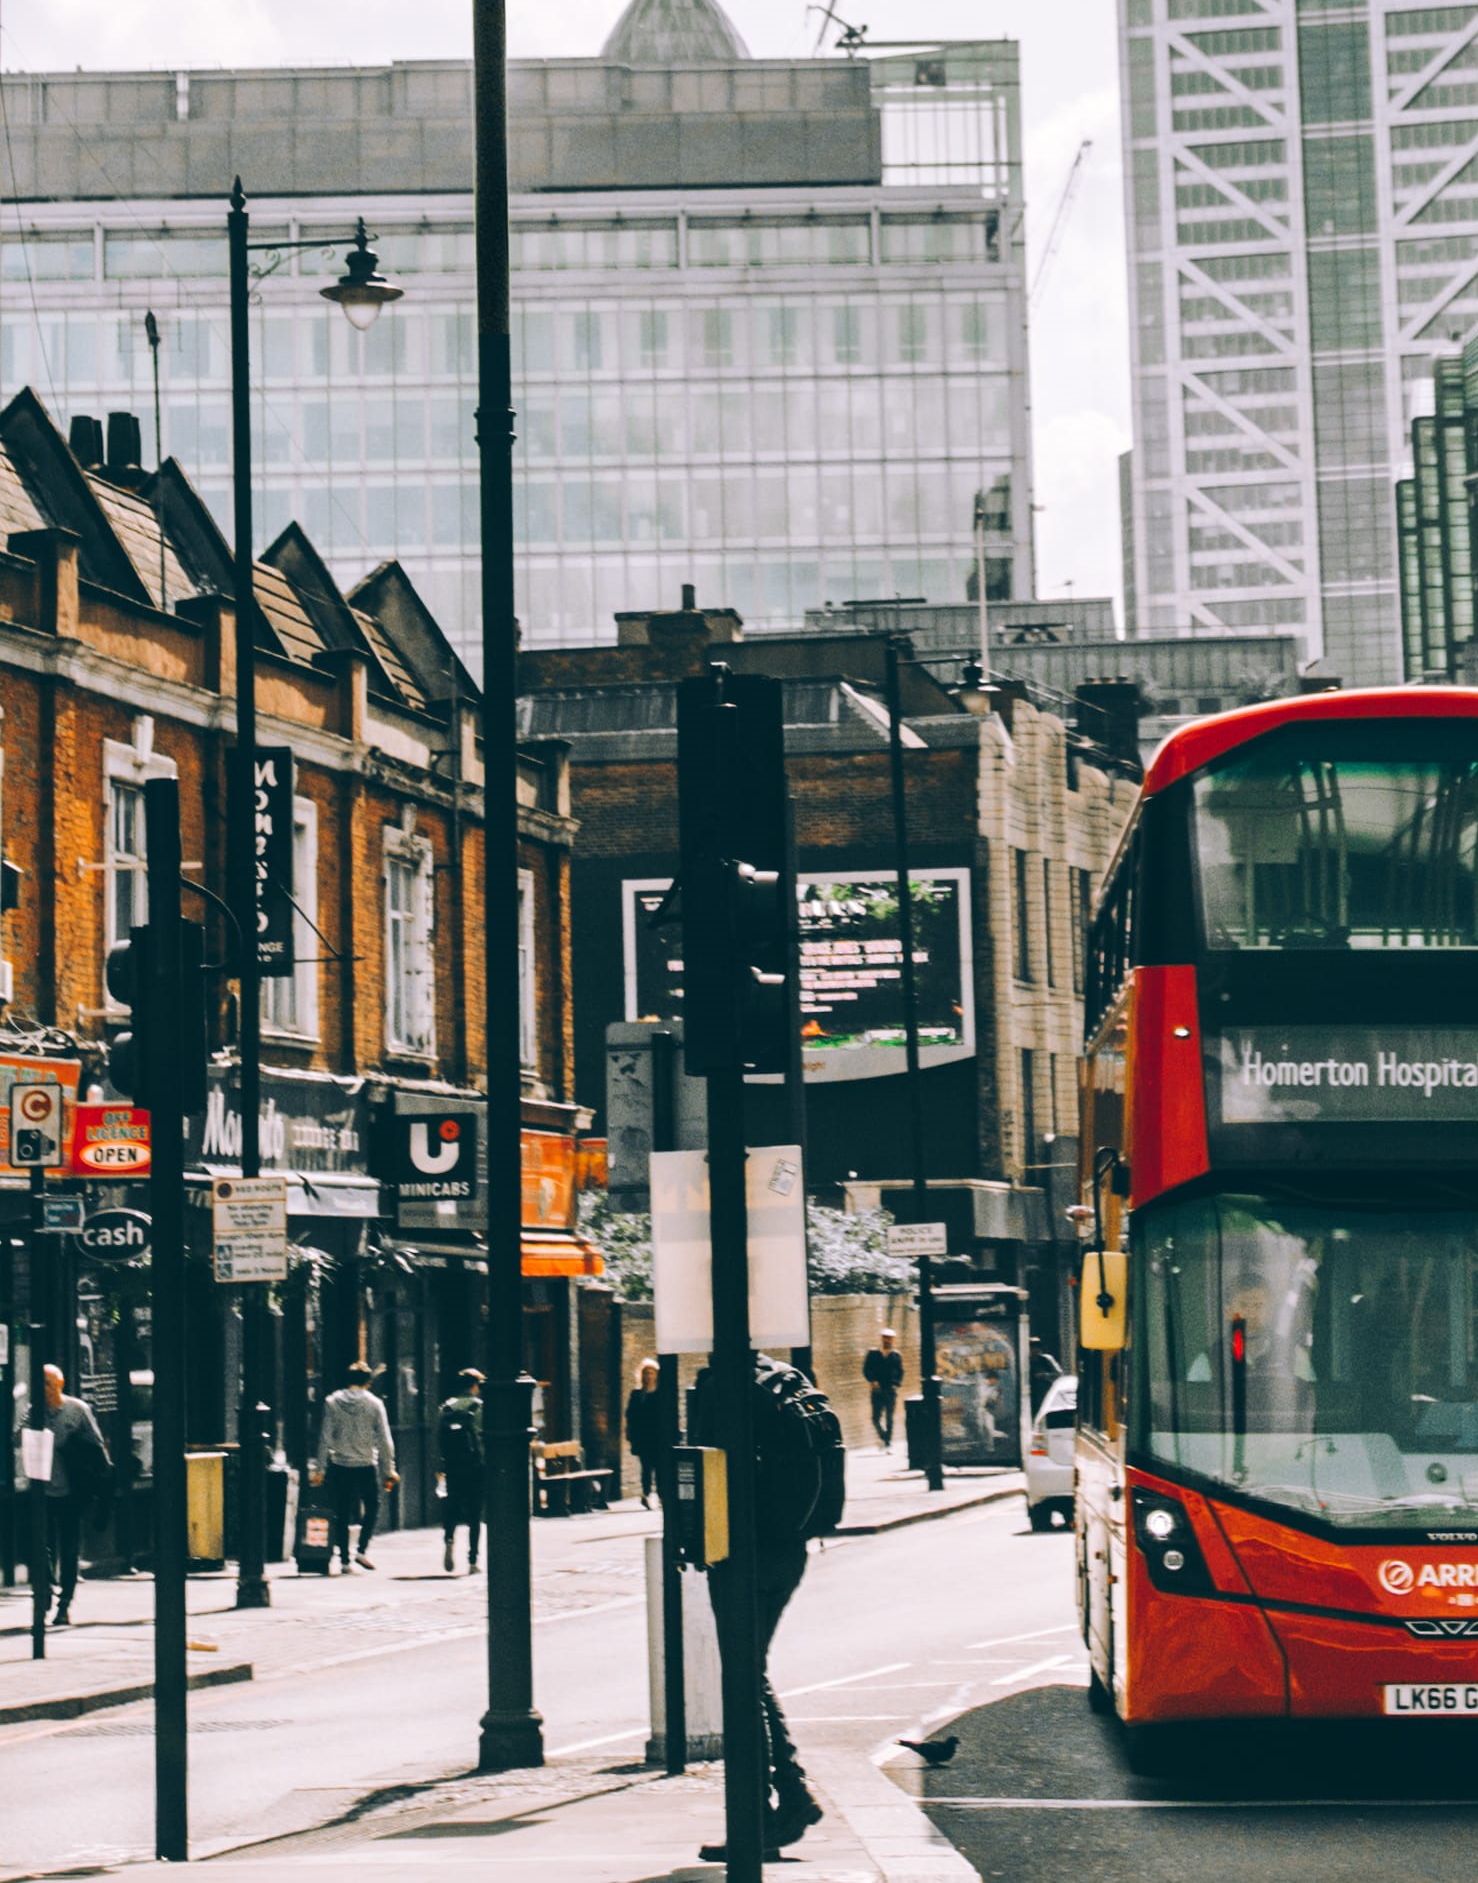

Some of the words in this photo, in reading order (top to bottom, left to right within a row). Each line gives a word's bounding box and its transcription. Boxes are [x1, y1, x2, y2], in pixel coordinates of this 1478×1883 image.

[1243, 1051, 1369, 1086] Homerton
[86, 1125, 147, 1141] LICENCE
[93, 1148, 138, 1163] OPEN
[398, 1181, 471, 1197] MINICABS
[83, 1220, 145, 1246] cash
[1427, 1532, 1478, 1541] VOLVO
[1395, 1687, 1458, 1710] LK66
